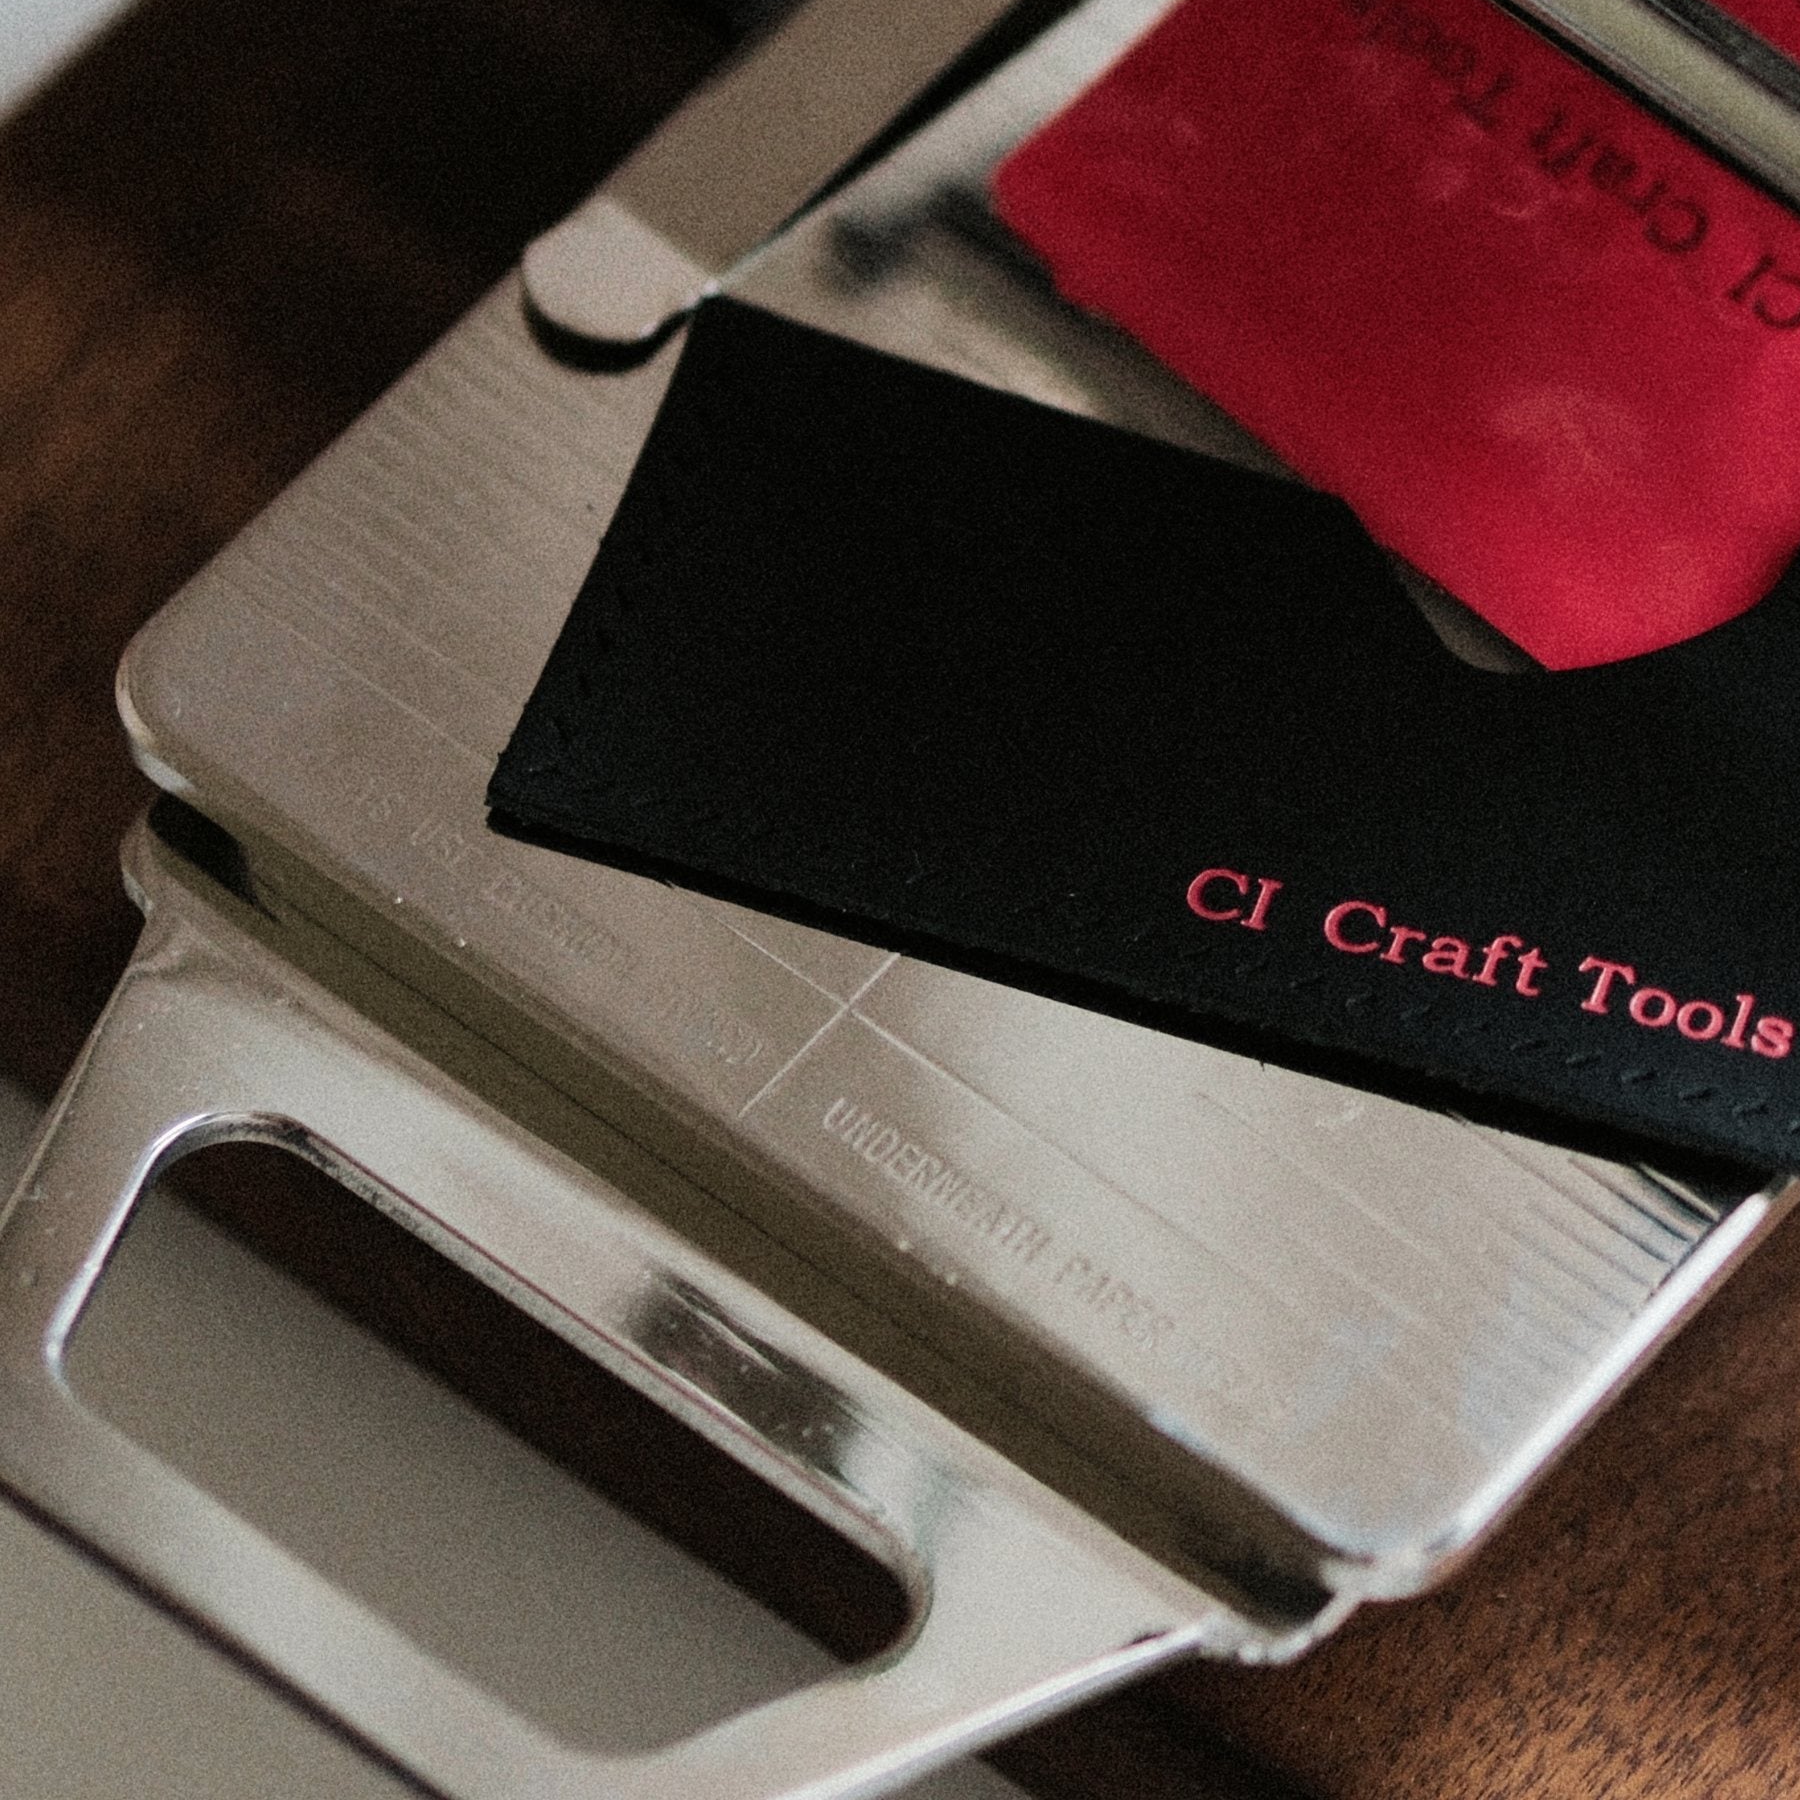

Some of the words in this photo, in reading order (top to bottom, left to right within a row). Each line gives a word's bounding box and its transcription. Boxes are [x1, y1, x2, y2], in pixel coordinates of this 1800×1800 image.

[1530, 110, 1711, 255] Craft
[1187, 868, 1283, 930] CI
[1324, 900, 1548, 996] Craft
[1579, 956, 1795, 1058] Tools
[819, 1095, 1054, 1263] UNDERNEATH
